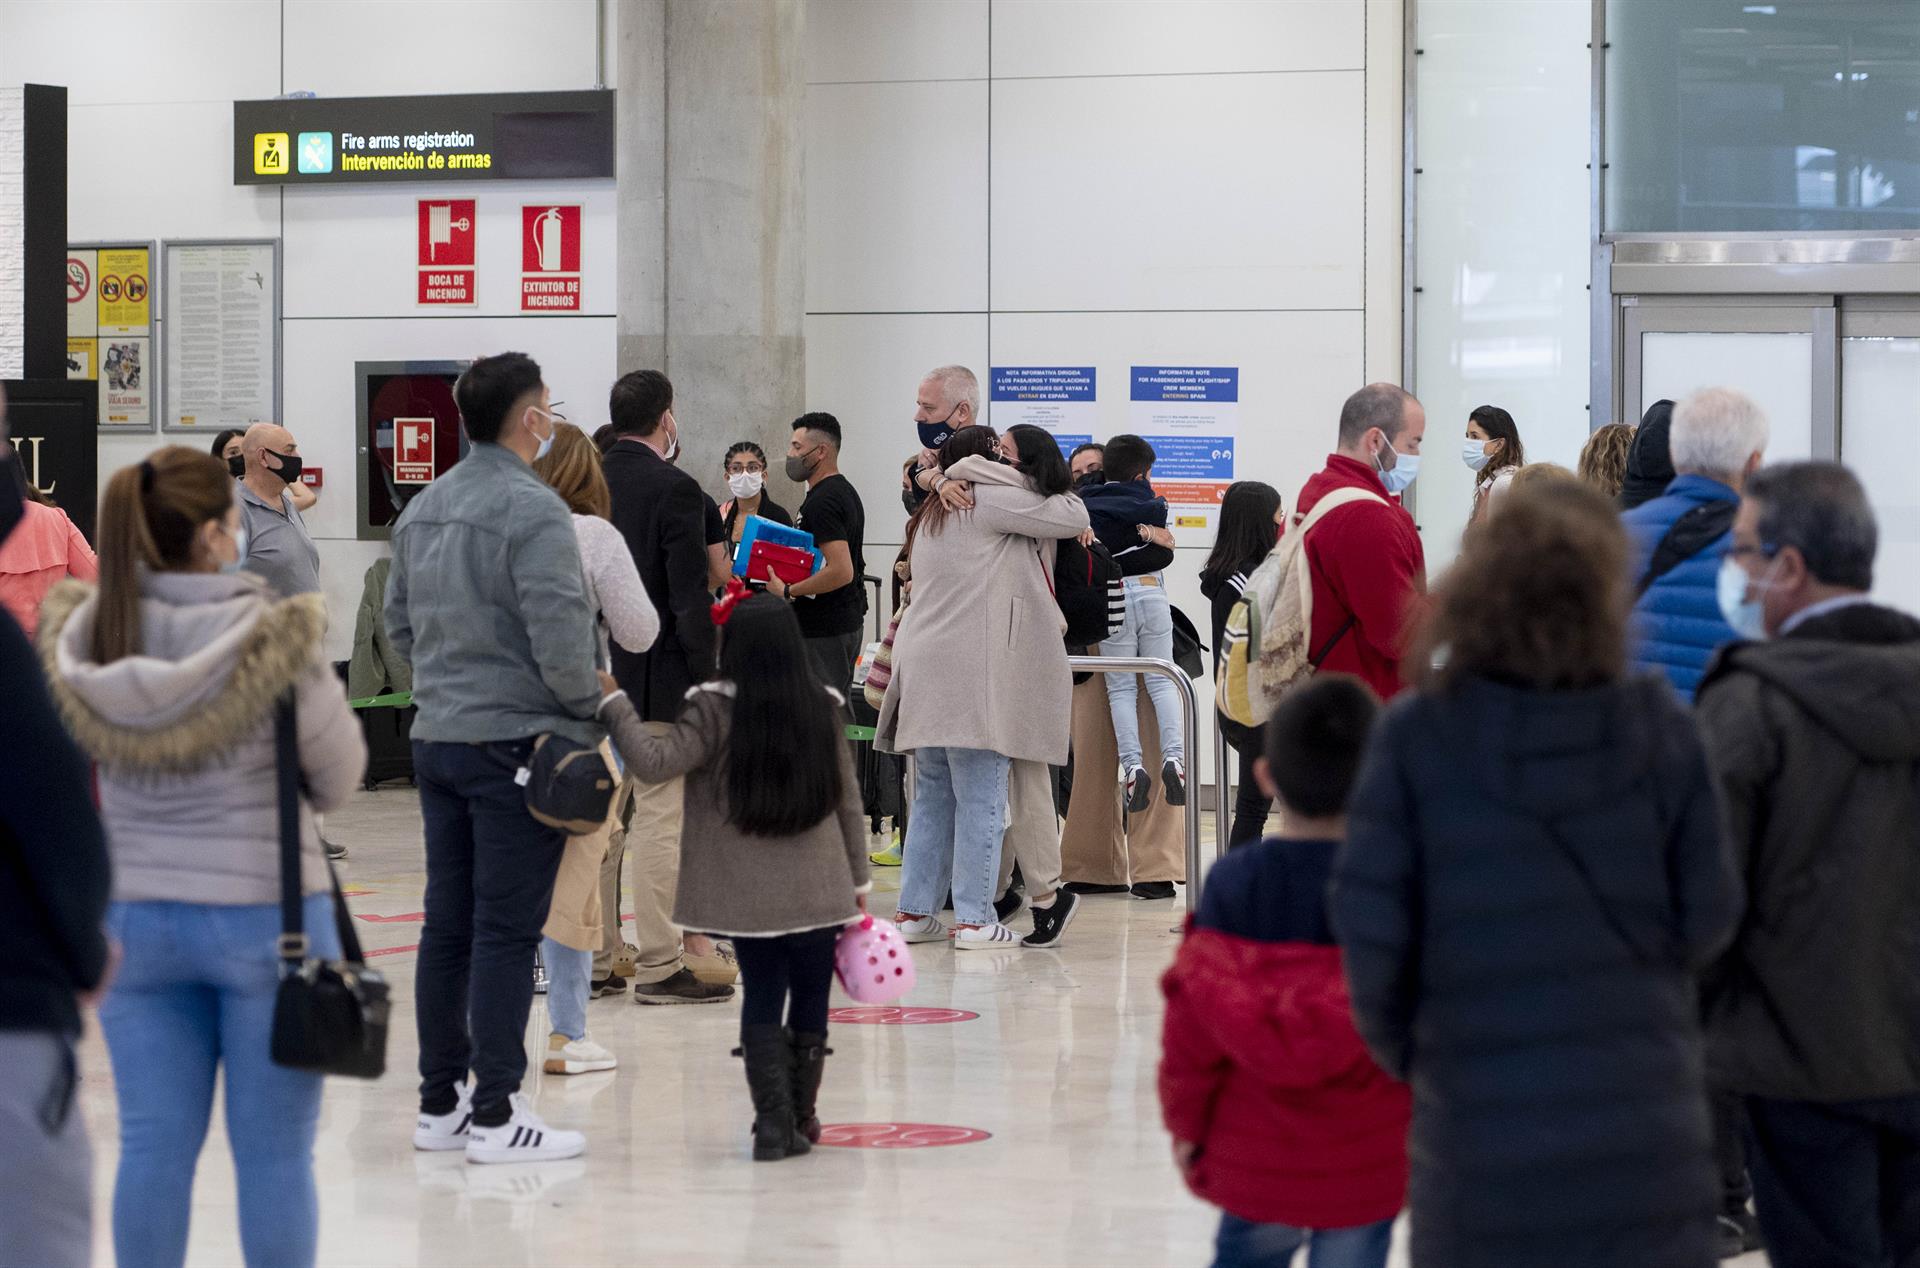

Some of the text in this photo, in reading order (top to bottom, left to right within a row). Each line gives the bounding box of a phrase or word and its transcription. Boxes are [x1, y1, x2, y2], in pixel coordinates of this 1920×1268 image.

[341, 131, 474, 151] Fire arms registration
[341, 151, 491, 171] Intervención de armas
[428, 274, 465, 286] BOCA DE
[523, 281, 578, 293] EXTINTOR DE
[426, 288, 466, 300] INCENDIO
[527, 295, 574, 307] INCENDIOS
